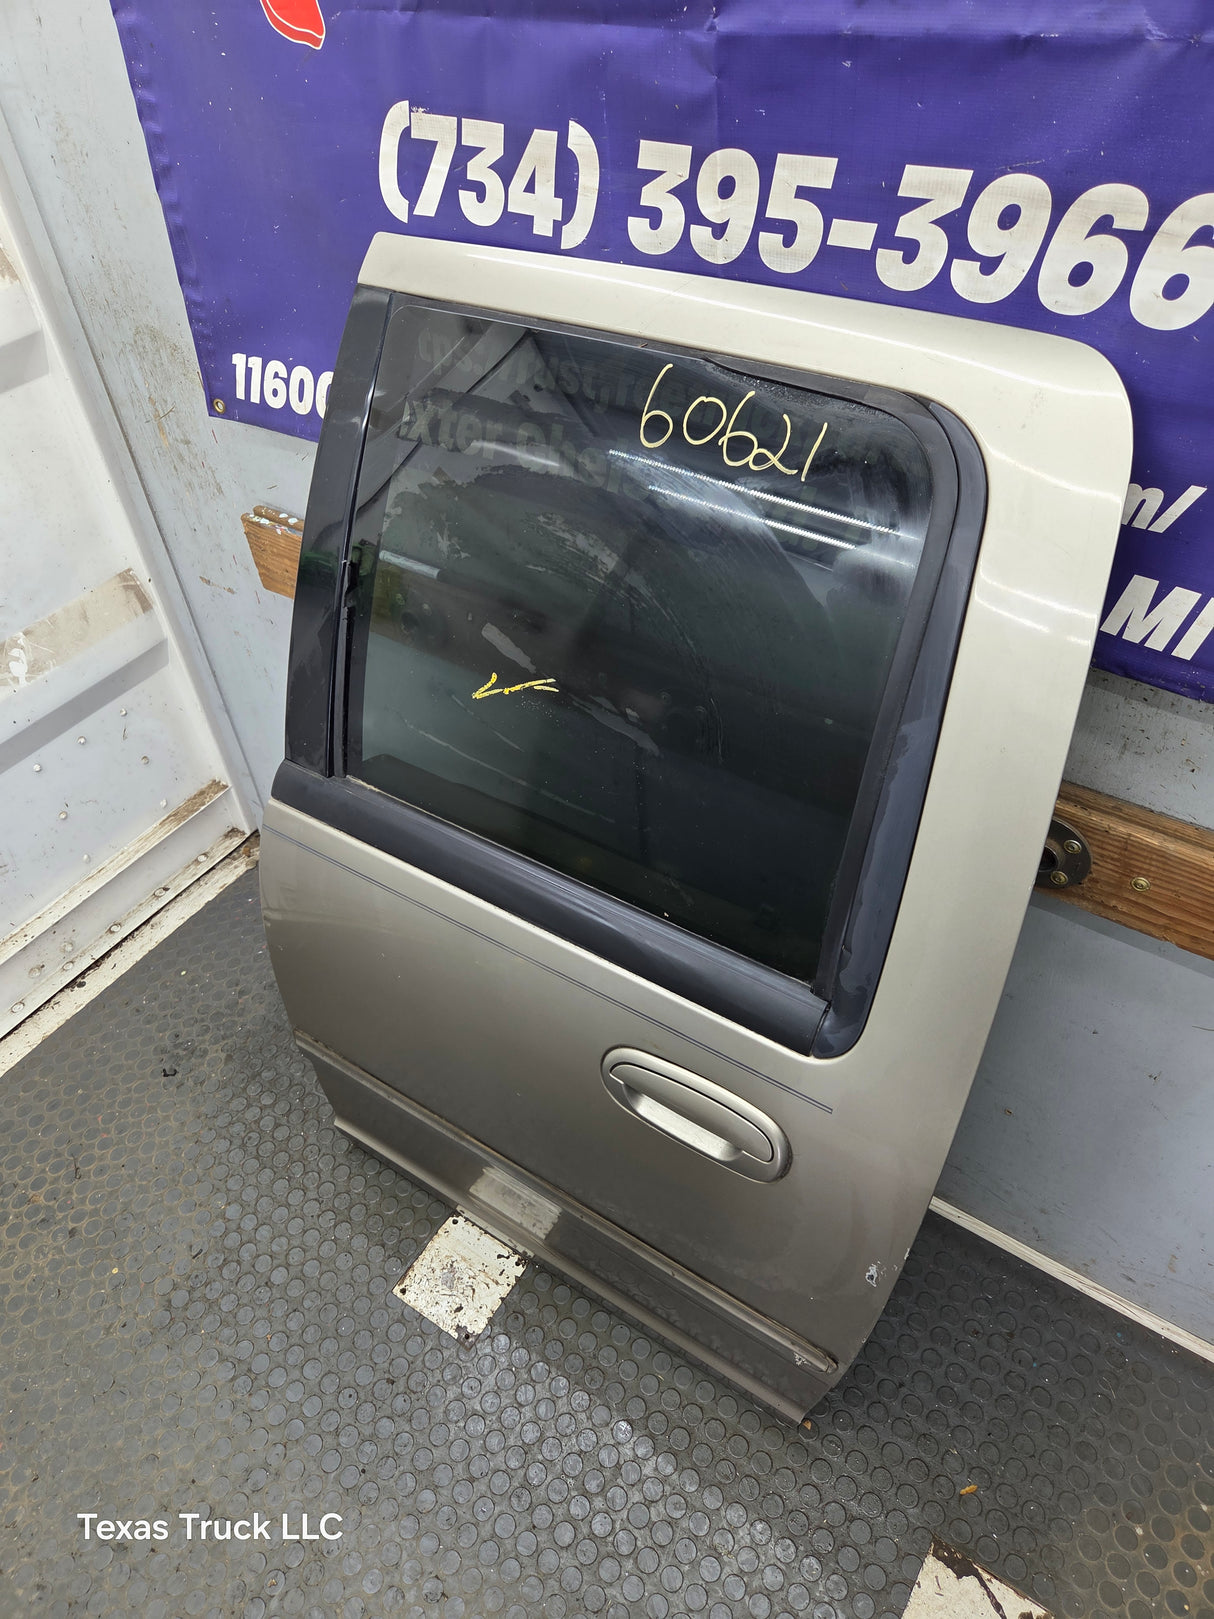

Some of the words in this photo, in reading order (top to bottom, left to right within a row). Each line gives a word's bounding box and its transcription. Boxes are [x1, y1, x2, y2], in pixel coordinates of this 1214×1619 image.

[378, 100, 600, 250] (734)
[627, 139, 1214, 331] 395-3966
[640, 363, 828, 482] 60621
[1099, 574, 1214, 661] MI
